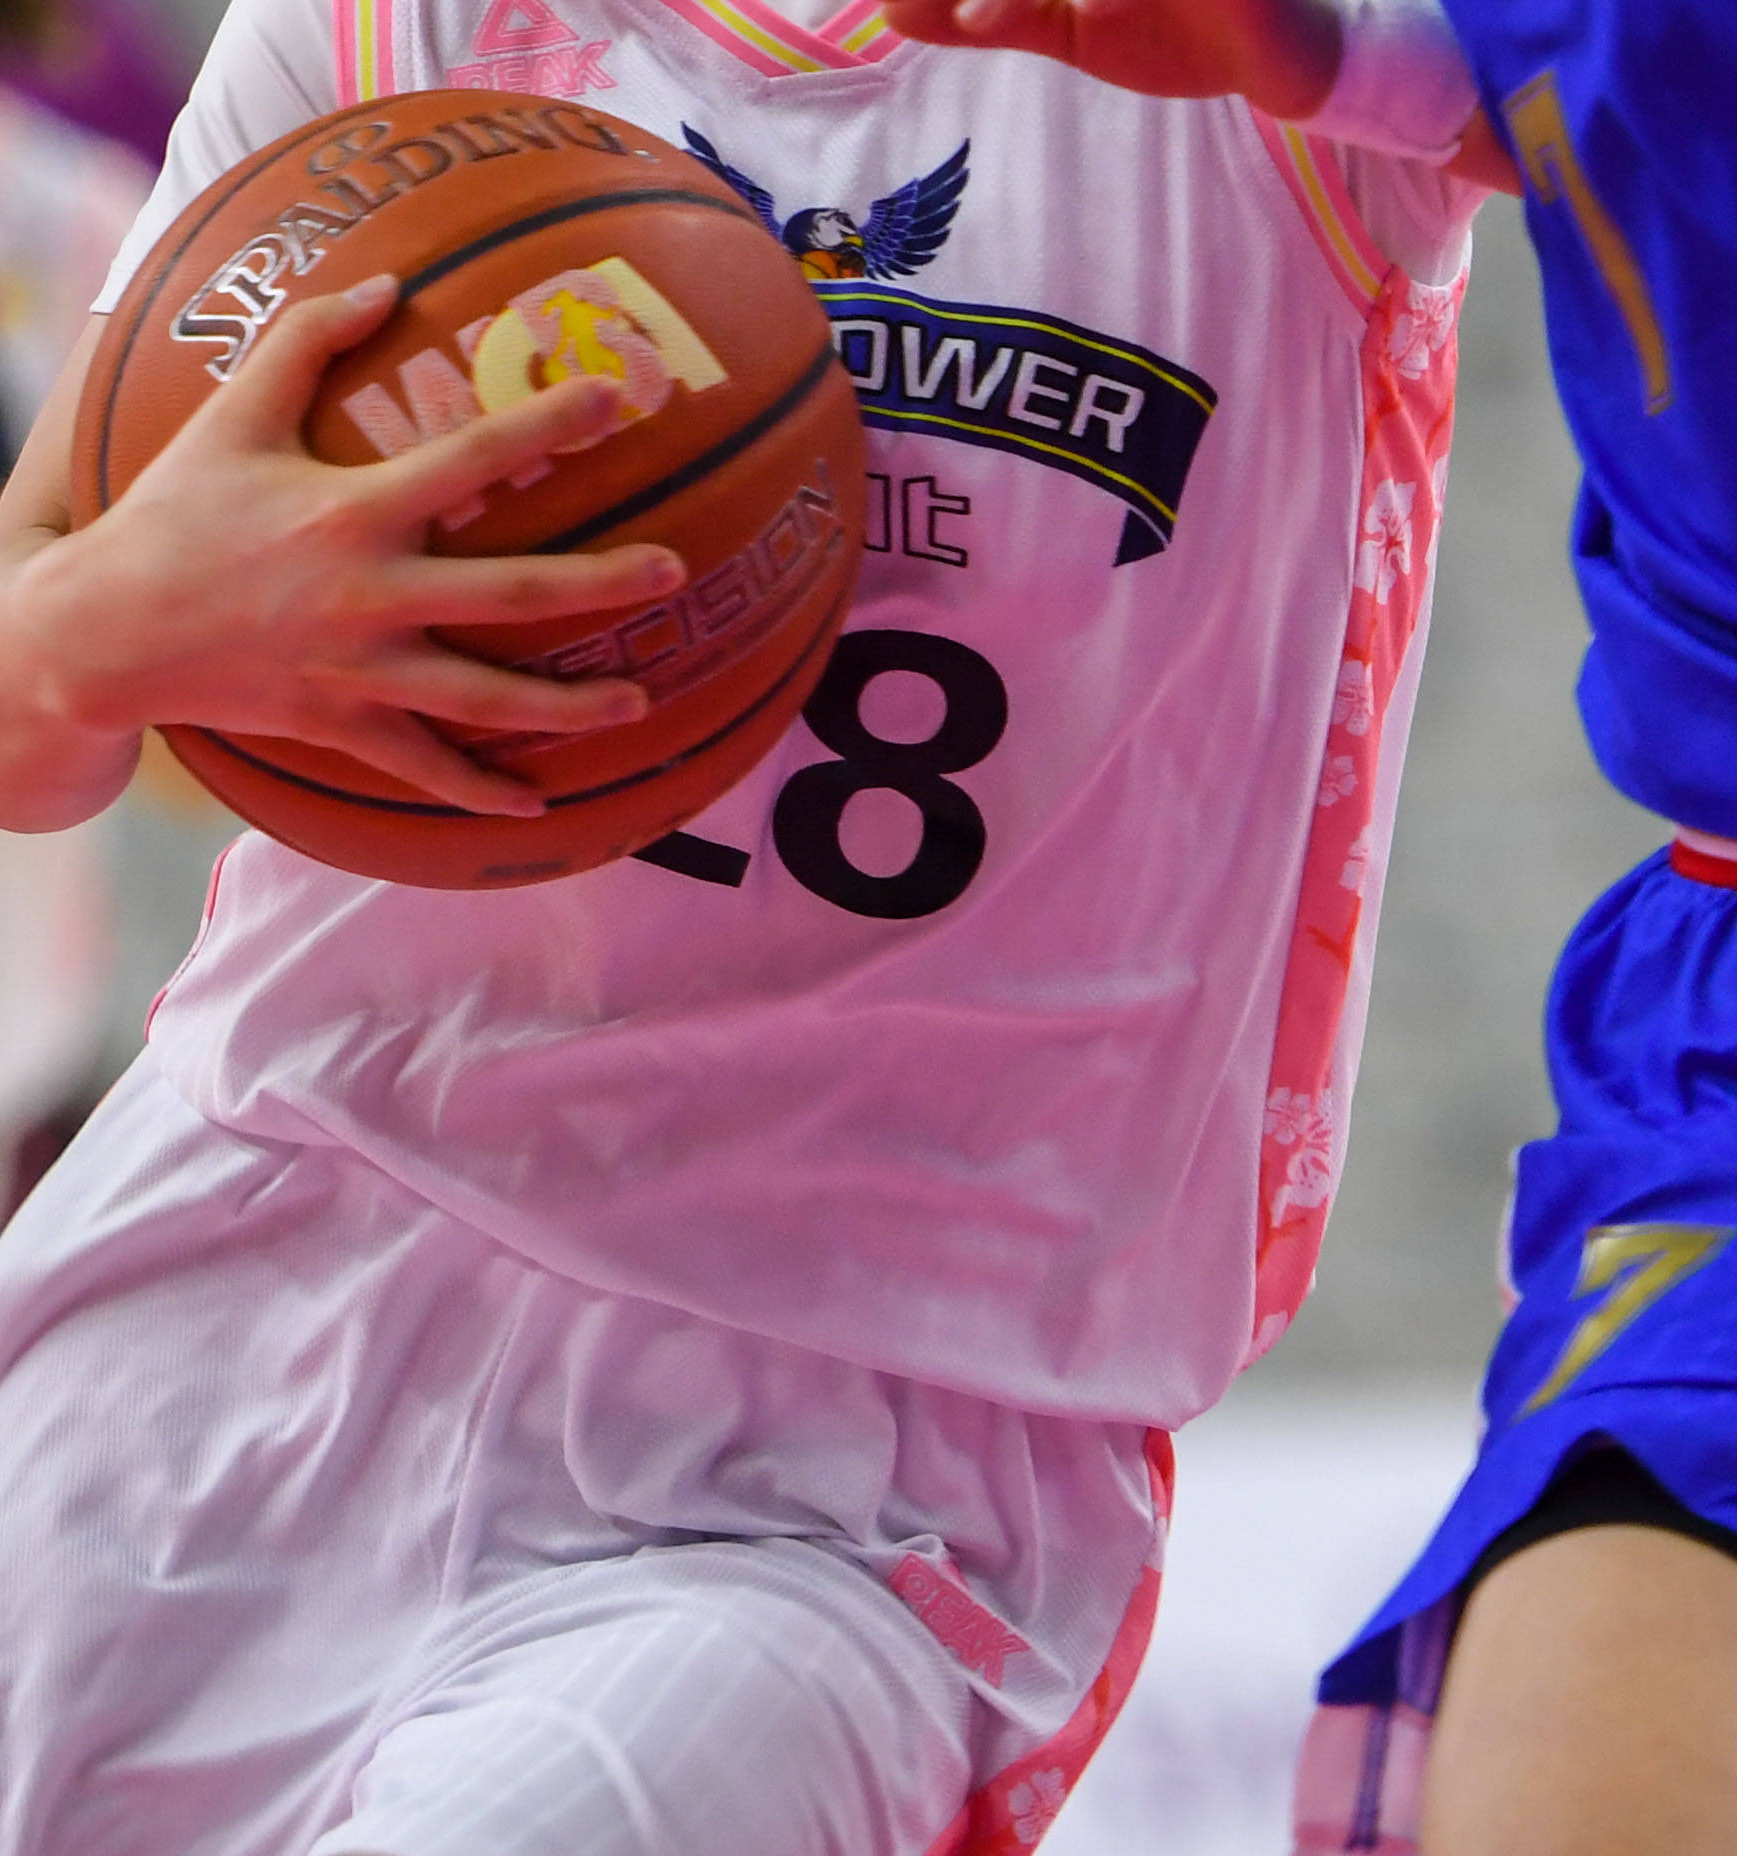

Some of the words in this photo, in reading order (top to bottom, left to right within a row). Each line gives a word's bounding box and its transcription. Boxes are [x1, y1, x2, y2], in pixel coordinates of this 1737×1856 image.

[445, 40, 618, 97] PEAK
[169, 104, 628, 383] SPALDING
[1503, 70, 1673, 414] 7
[527, 458, 846, 680] ECISION
[629, 628, 1008, 920] 8
